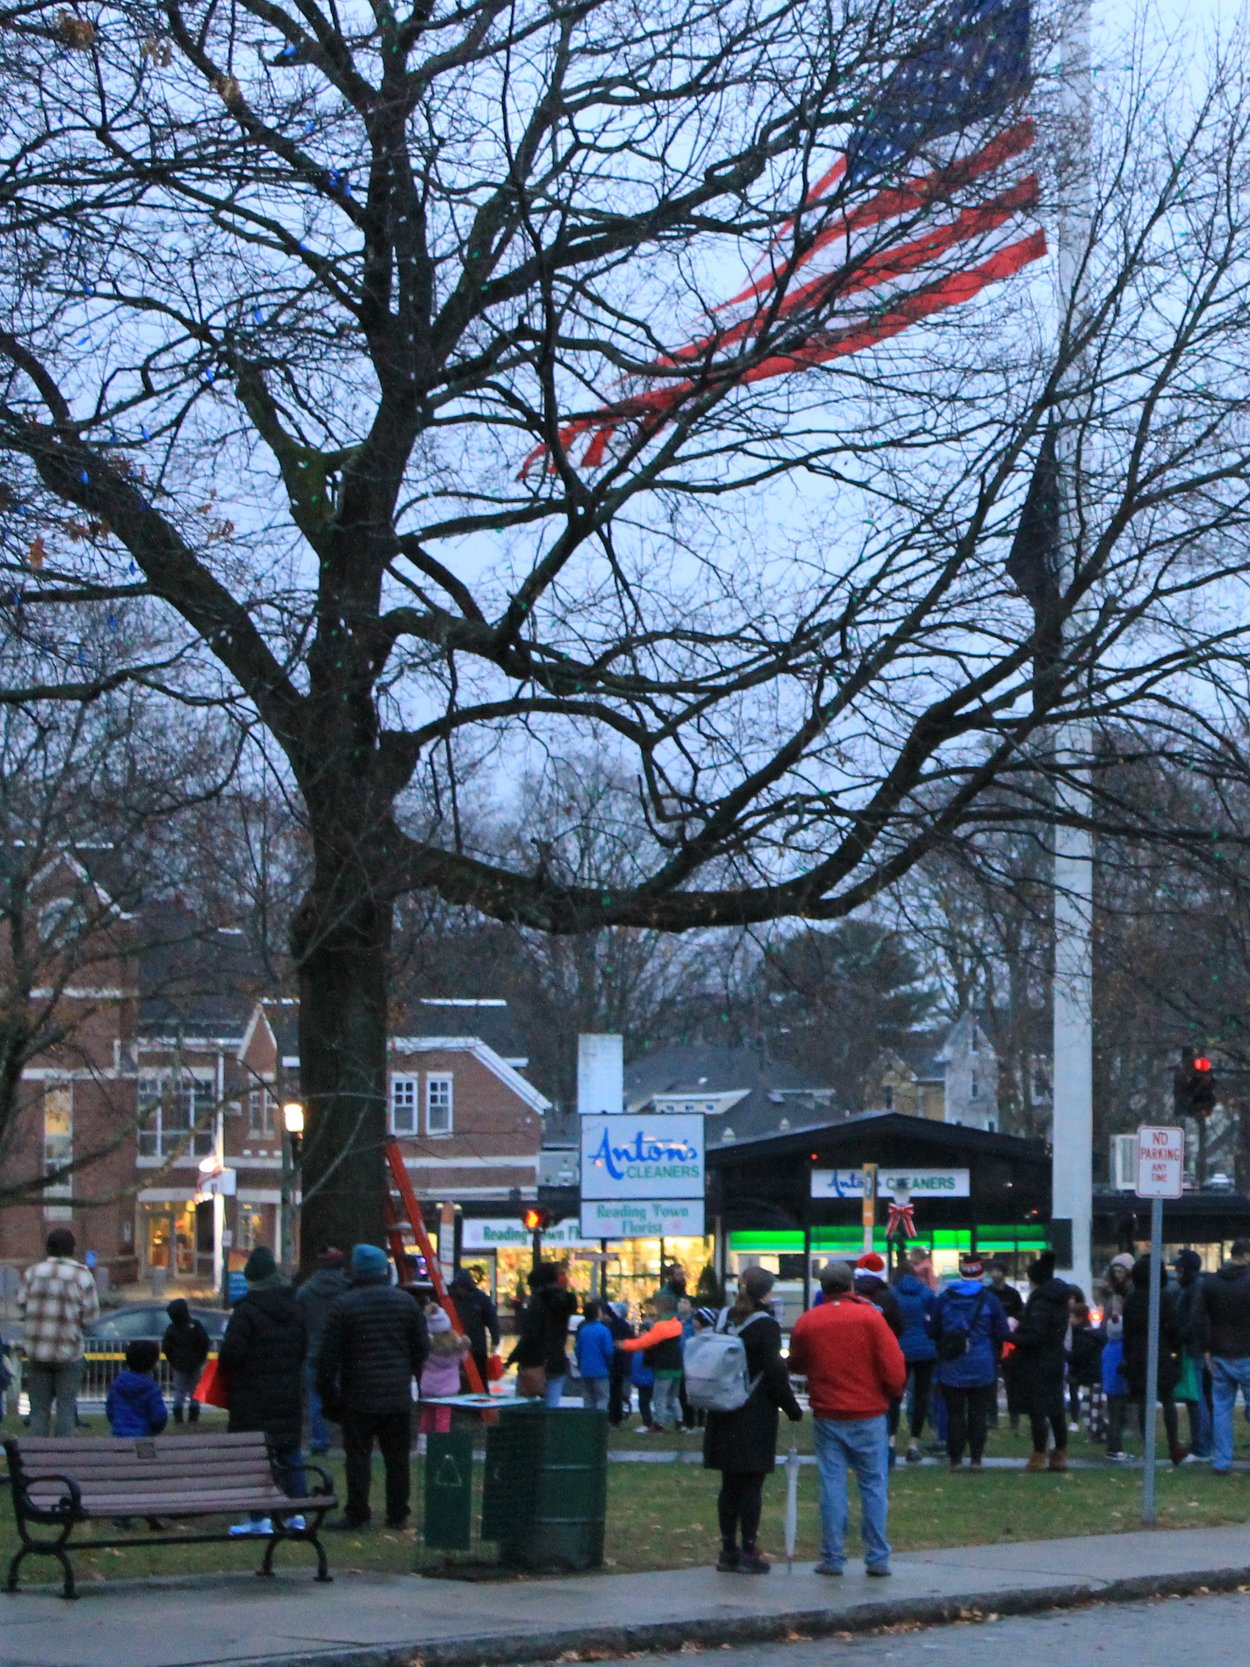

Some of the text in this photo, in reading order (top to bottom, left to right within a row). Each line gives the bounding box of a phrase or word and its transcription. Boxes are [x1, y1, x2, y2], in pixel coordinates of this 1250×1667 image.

[1152, 1132, 1169, 1145] NO
[588, 1127, 698, 1180] Anton's
[1141, 1147, 1180, 1161] PARKING
[626, 1165, 700, 1179] CLEANERS
[1152, 1164, 1167, 1172] ANY
[1152, 1173, 1168, 1182] TIME
[597, 1204, 690, 1220] Reading Town
[622, 1220, 663, 1233] Florist
[483, 1225, 528, 1245] Reading
